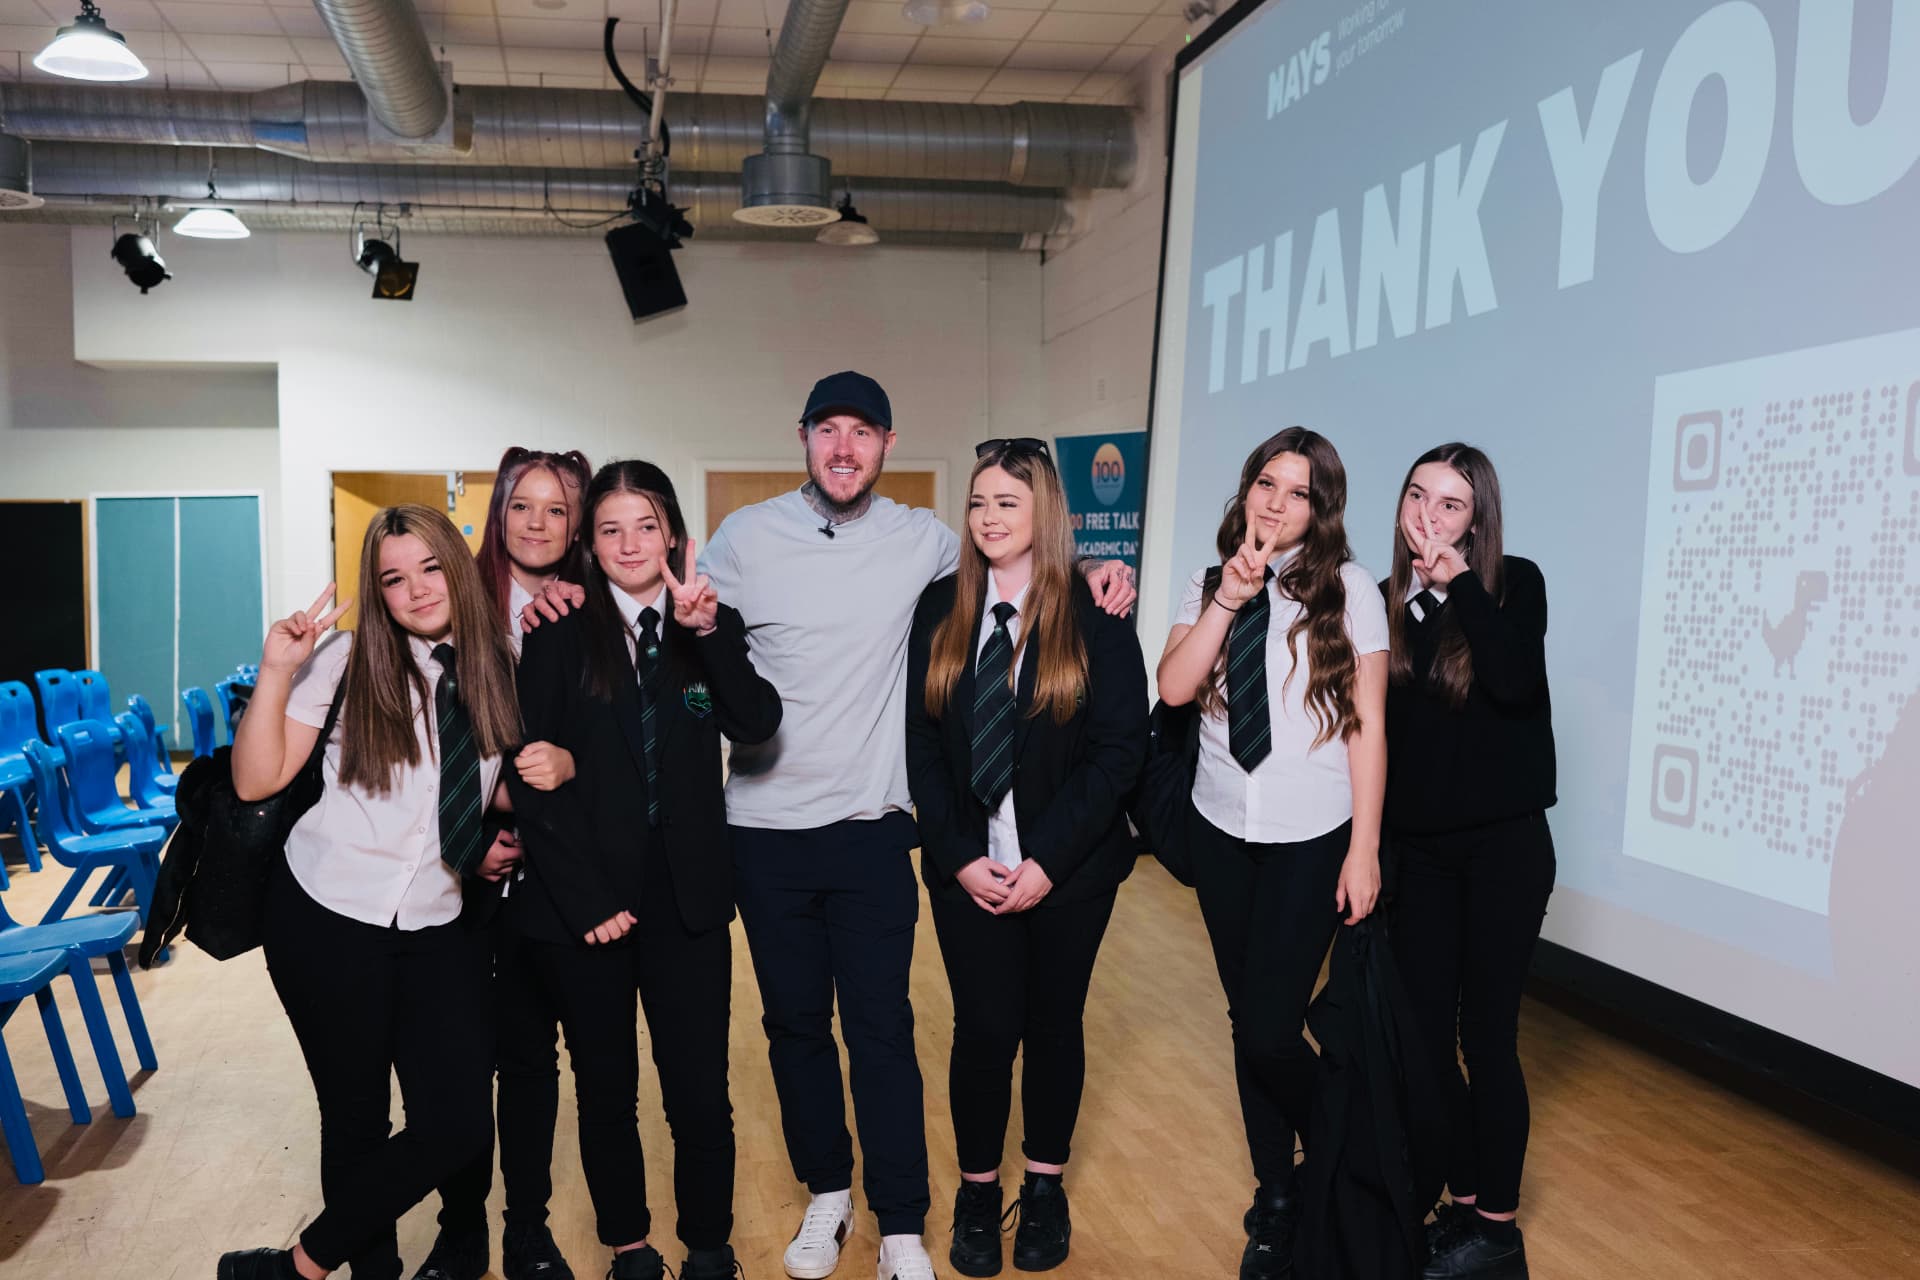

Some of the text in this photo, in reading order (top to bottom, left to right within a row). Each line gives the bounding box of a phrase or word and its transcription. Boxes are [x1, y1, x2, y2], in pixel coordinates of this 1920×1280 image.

[1267, 31, 1331, 121] HAYS
[1202, 0, 1920, 394] THANK YOU
[1095, 461, 1121, 483] 100
[1085, 512, 1110, 530] FREE
[1112, 511, 1140, 530] TALK
[1077, 541, 1122, 555] ACADEMIC
